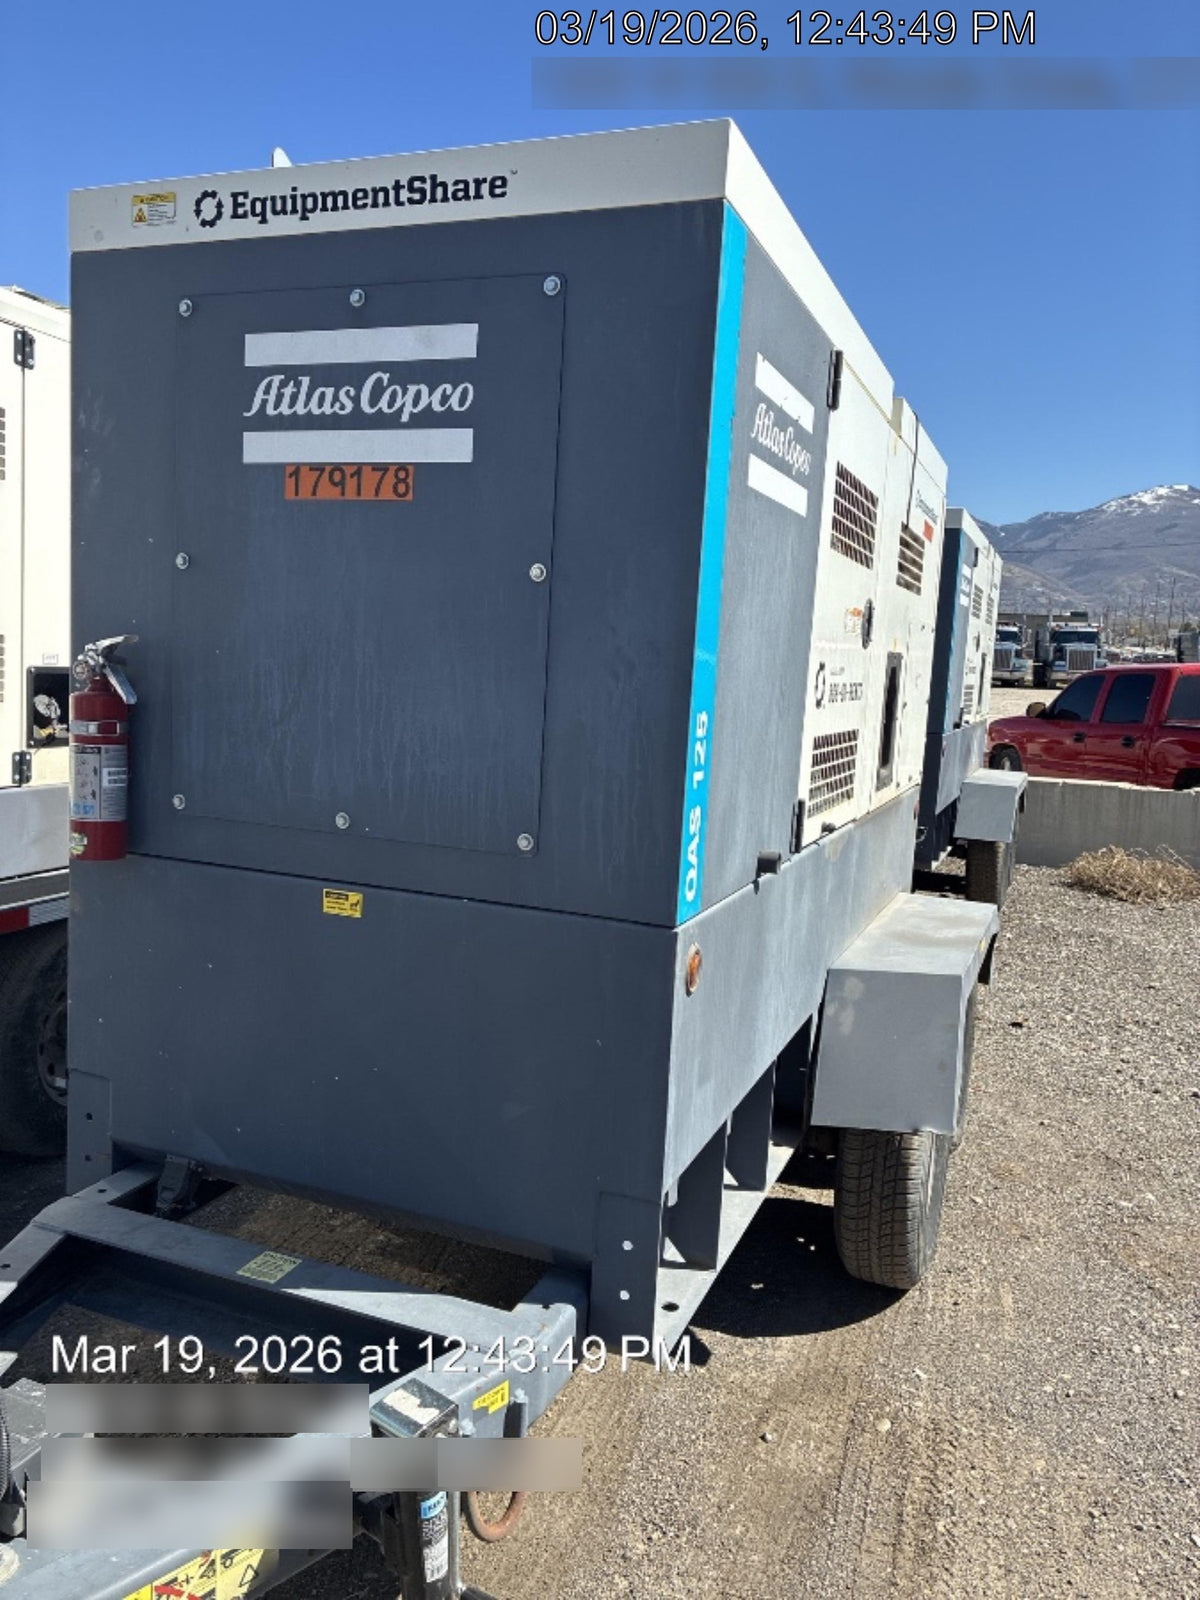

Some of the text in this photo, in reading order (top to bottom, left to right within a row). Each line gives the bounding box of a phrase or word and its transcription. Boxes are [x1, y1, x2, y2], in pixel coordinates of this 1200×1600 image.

[230, 173, 508, 224] EquipmentShare
[243, 371, 474, 422] Atlas Copco
[750, 402, 784, 457] Atlas
[288, 465, 411, 498] 179178
[692, 710, 709, 790] 125
